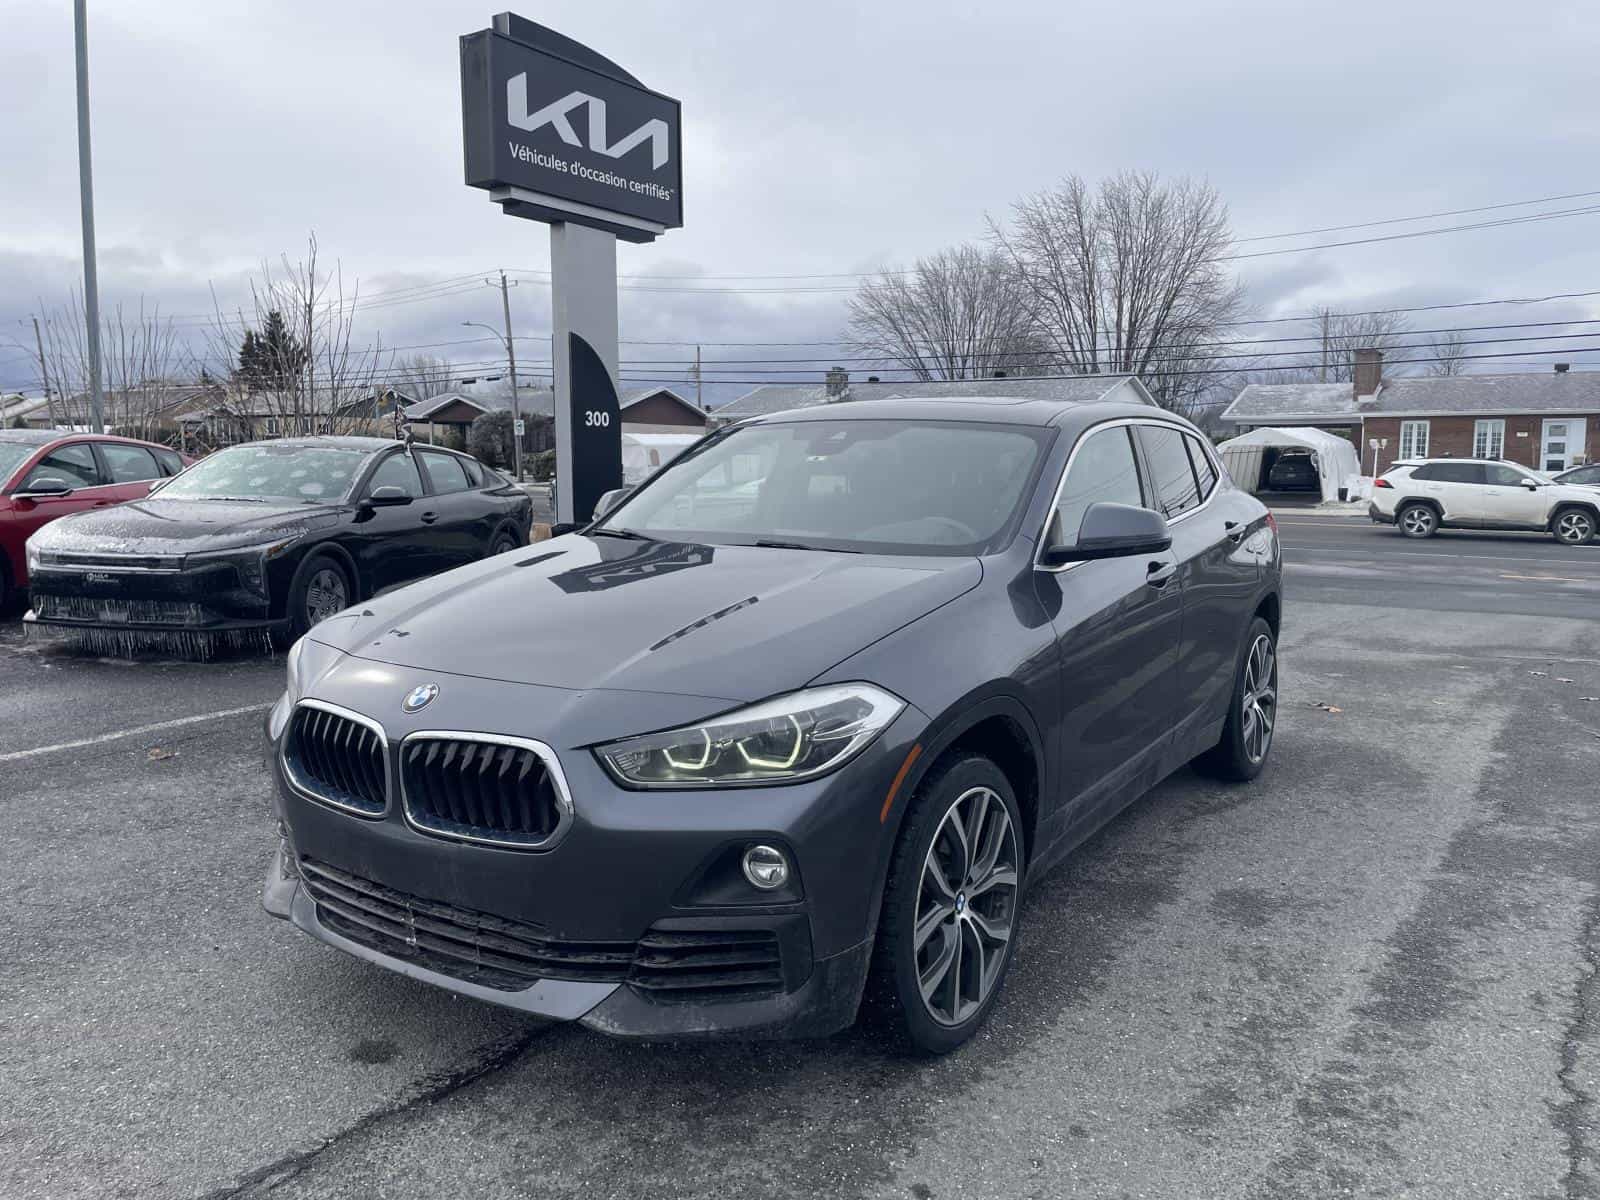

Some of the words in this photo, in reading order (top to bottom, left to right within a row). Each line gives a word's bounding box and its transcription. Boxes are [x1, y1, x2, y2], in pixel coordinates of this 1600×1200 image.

[507, 72, 669, 170] KIA
[508, 141, 568, 173] Véhicules
[570, 160, 627, 189] d'occasion
[629, 180, 670, 201] certifiés
[585, 410, 610, 427] 300
